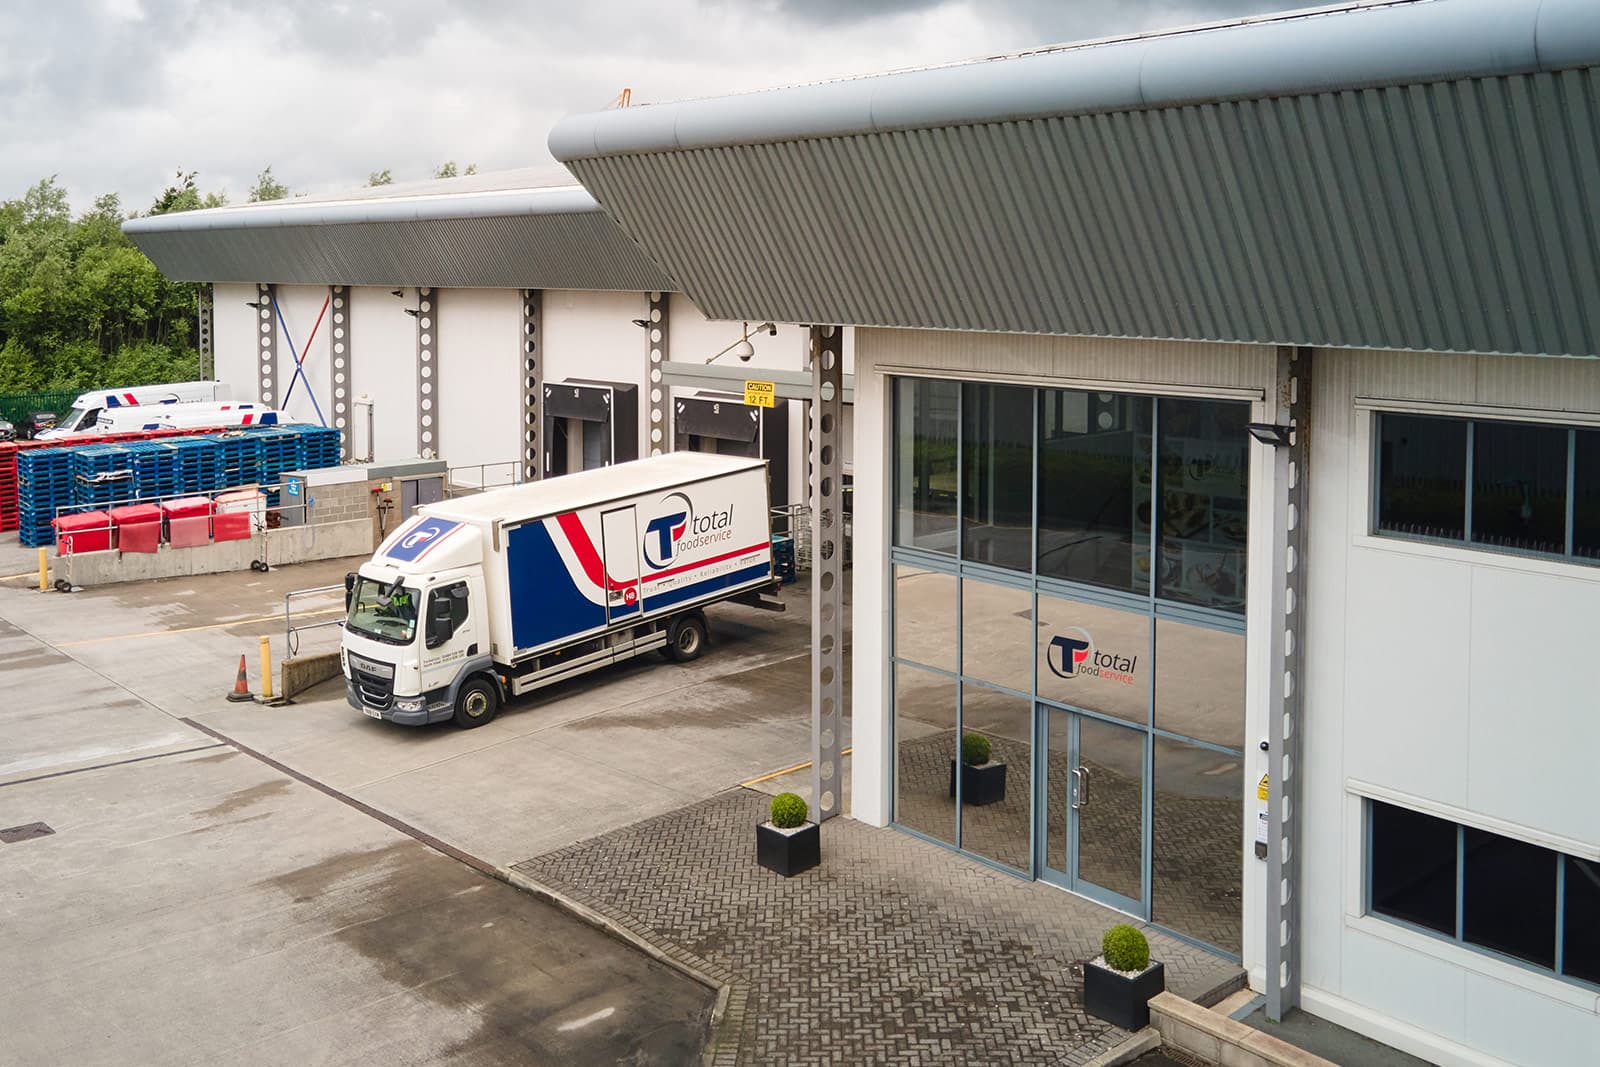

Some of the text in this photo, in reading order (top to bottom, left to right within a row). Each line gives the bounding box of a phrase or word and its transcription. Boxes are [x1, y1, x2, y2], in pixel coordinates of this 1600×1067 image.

[748, 383, 772, 392] CAUTION
[749, 395, 756, 404] 12
[692, 503, 734, 536] total
[676, 528, 732, 557] foodservice
[360, 663, 377, 672] DAF
[1093, 649, 1138, 674] total
[1076, 662, 1135, 685] foodservice
